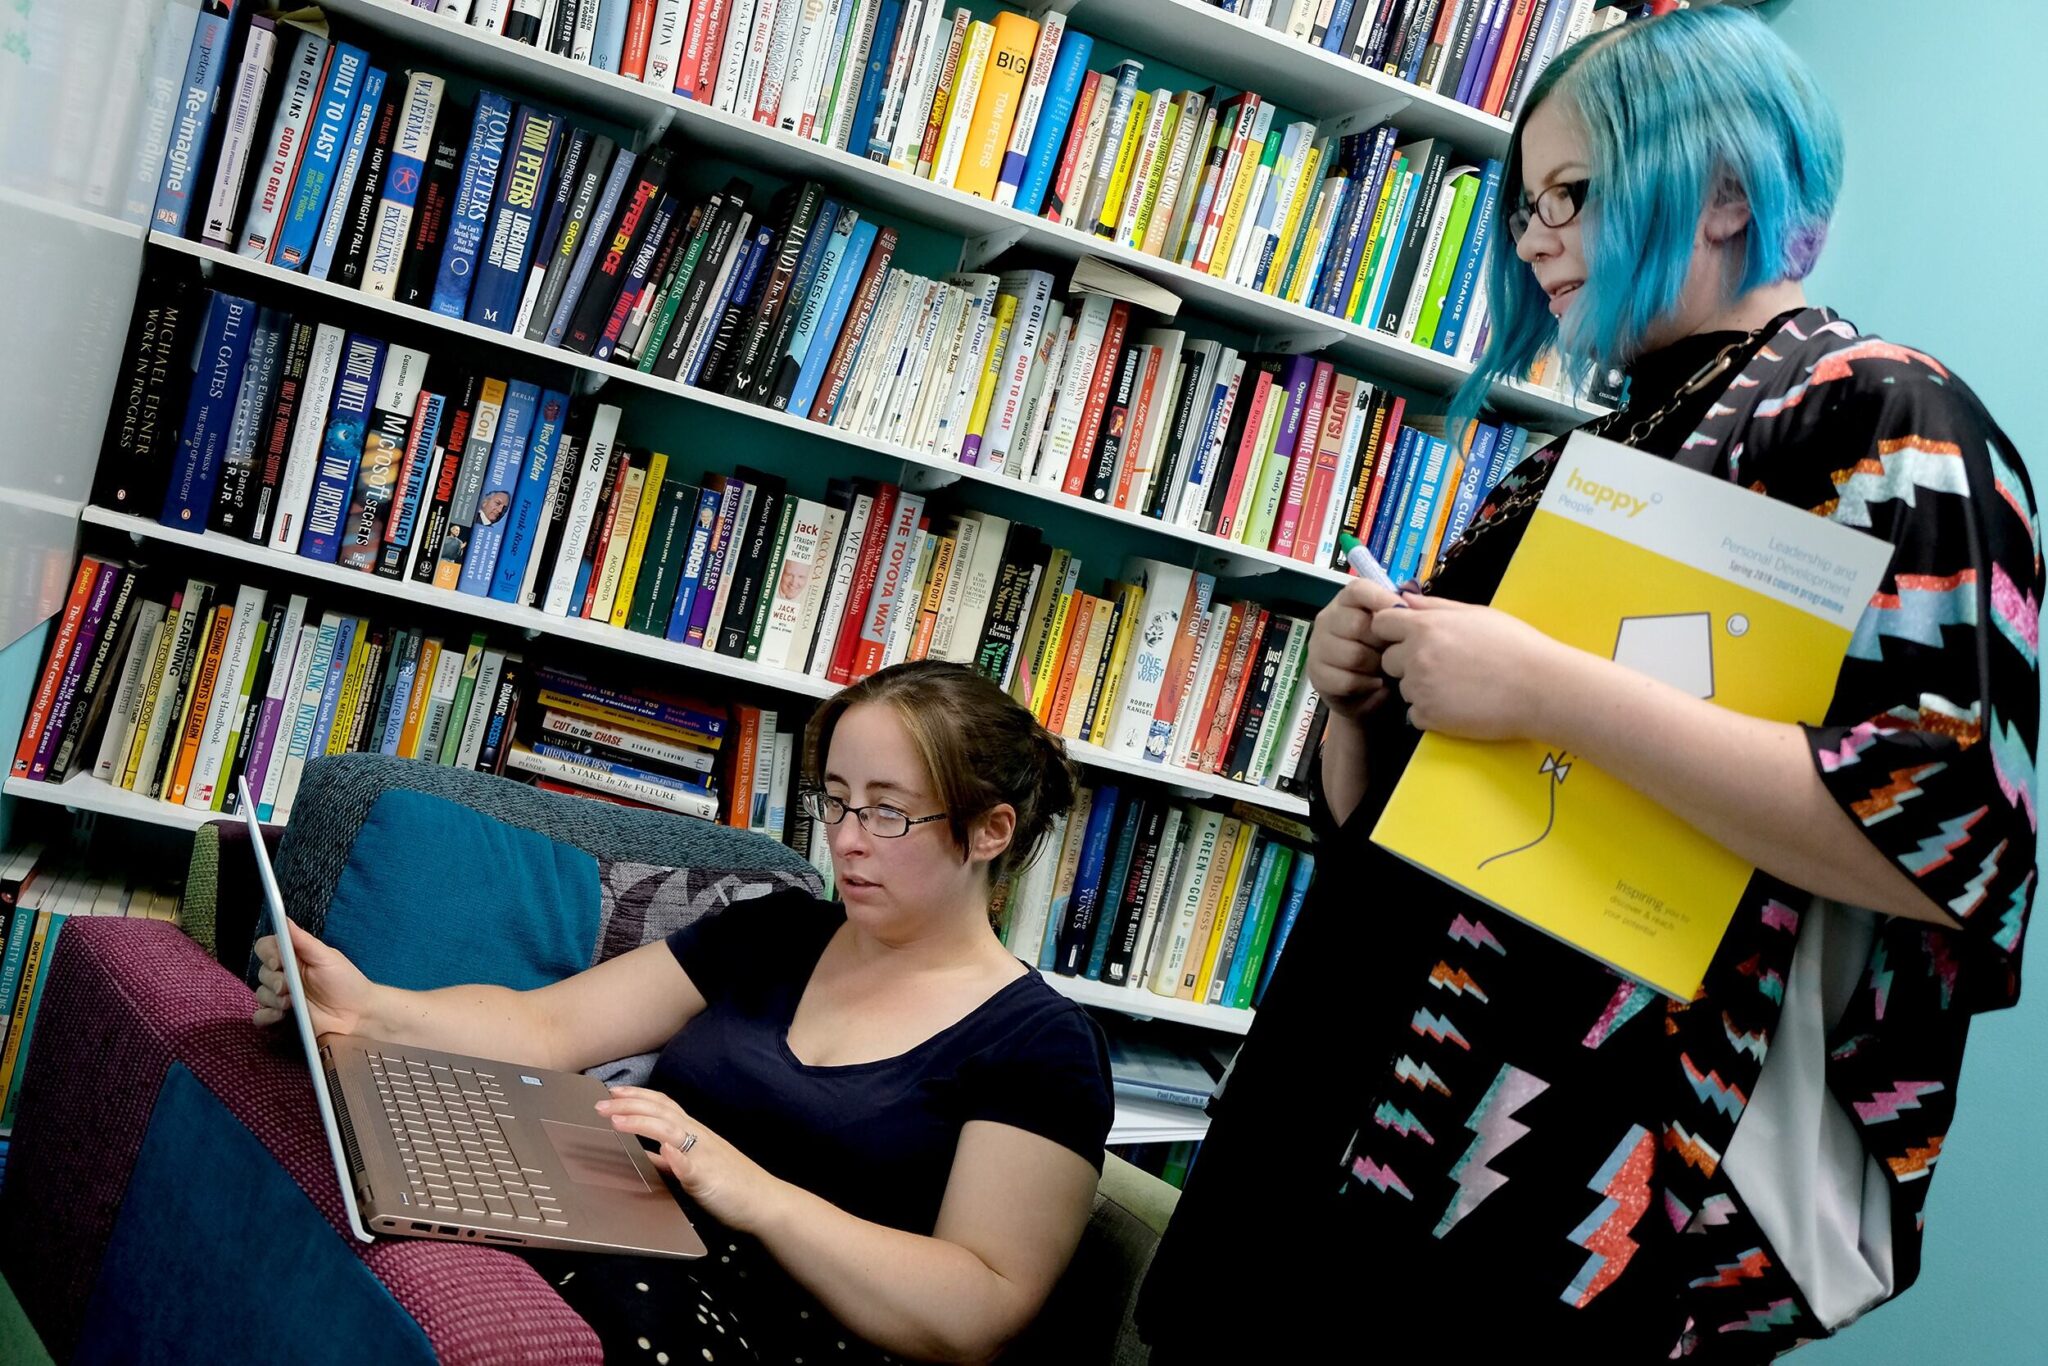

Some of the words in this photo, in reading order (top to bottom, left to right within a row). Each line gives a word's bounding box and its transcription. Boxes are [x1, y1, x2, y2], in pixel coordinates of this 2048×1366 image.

[302, 41, 318, 66] JIM
[996, 50, 1026, 74] BIG
[332, 53, 359, 98] BUILT
[287, 69, 311, 119] COLLINS
[325, 100, 346, 121] TO
[1155, 99, 1168, 117] 1001
[353, 102, 372, 145] BEYOND
[400, 79, 433, 153] WATERMAN
[1149, 118, 1162, 139] WAYS
[1235, 104, 1256, 140] Savvy
[162, 85, 208, 199] Re-imagine!
[276, 126, 295, 158] GOOD
[313, 122, 338, 162] LAST
[521, 115, 552, 152] TOM
[1146, 138, 1156, 149] TO
[1167, 116, 1195, 177] HAPPINESS
[271, 159, 286, 175] TO
[370, 147, 384, 172] HOW
[1137, 148, 1154, 180] ENERGIZE
[261, 176, 280, 213] GREAT
[322, 146, 359, 247] ENTREPRENEURSHIP
[364, 173, 378, 193] THE
[507, 150, 543, 209] PETERS
[579, 172, 597, 203] BUILT
[1158, 175, 1178, 209] NOW!
[355, 193, 373, 232] MIGHTY
[572, 203, 586, 220] TO
[797, 190, 815, 225] CHARLES
[1127, 179, 1145, 218] EMPLOYEES
[371, 205, 401, 275] EXCELLENCE
[487, 207, 514, 267] MANAGEMENT
[560, 220, 579, 256] GROW
[600, 179, 653, 275] DIFFERENCE
[1471, 194, 1494, 255] IMMUNITY
[348, 232, 363, 255] FALL
[501, 211, 532, 273] LIBERATION
[776, 223, 807, 272] HANDY
[769, 278, 786, 298] The
[866, 252, 891, 301] CAPITALISM
[1035, 280, 1047, 301] JIM
[762, 297, 778, 316] New
[860, 299, 874, 312] IS
[1451, 271, 1472, 320] CHANGE
[139, 308, 160, 352] WORK
[222, 302, 243, 341] BILL
[852, 310, 869, 338] DEAD:
[1022, 304, 1042, 347] COLLINS
[149, 306, 179, 385] MICHAEL
[743, 318, 770, 366] Alchemists
[135, 357, 149, 374] IN
[208, 344, 232, 398] GATES
[344, 340, 377, 382] INSIDE
[1013, 354, 1028, 382] GOOD
[1116, 349, 1138, 404] MAVERICK!
[336, 378, 369, 413] INTEL
[826, 378, 843, 405] RULES
[1009, 384, 1020, 397] TO
[1293, 380, 1307, 405] Open
[119, 377, 145, 448] PROGRESS
[134, 393, 160, 454] EISNER
[475, 404, 497, 438] iCon
[1000, 398, 1016, 430] GREAT
[1286, 406, 1300, 434] Minds
[1325, 389, 1350, 440] NUTS!
[413, 397, 441, 464] REVOLUTION
[1298, 407, 1322, 455] ULTIMATE
[1497, 426, 1514, 452] SID'S
[321, 455, 351, 481] TIM
[365, 413, 407, 500] Microsoft
[409, 464, 424, 478] IN
[589, 441, 607, 472] iWoz
[1422, 441, 1447, 484] THRIVING
[1484, 450, 1506, 490] HEROES
[404, 479, 421, 500] THE
[578, 478, 597, 512] Steve
[1286, 454, 1311, 506] QUESTION
[1418, 482, 1435, 499] ON
[1566, 467, 1648, 518] happy
[308, 480, 344, 536] JACKSON
[394, 501, 415, 541] VALLEY
[720, 485, 741, 538] BUSINESS
[1409, 497, 1431, 530] CHAOS
[1557, 493, 1596, 515] People
[355, 498, 378, 546] SECRETS
[563, 514, 588, 563] Wozniak
[794, 519, 819, 536] jack
[896, 506, 916, 537] THE
[683, 530, 709, 578] IACOCCA
[706, 540, 726, 591] PIONEERS
[837, 530, 862, 585] WELCH
[880, 541, 907, 598] TOYOTA
[937, 541, 952, 571] ANYONE
[1720, 535, 1773, 566] Personal
[1773, 555, 1851, 598] Development
[1767, 535, 1832, 572] Leadership
[1832, 564, 1858, 581] and
[111, 572, 136, 620] LECTURING
[928, 589, 939, 603] DO
[932, 571, 944, 589] CAN
[1728, 559, 1753, 578] Spring
[1771, 576, 1800, 595] course
[1797, 587, 1844, 614] programme
[66, 604, 81, 622] The
[242, 600, 256, 618] The
[772, 609, 797, 623] WELCH
[777, 603, 795, 614] JACK
[871, 602, 890, 637] WAY
[60, 621, 75, 637] big
[103, 619, 118, 641] AND
[166, 609, 198, 679] LEARNING
[208, 613, 228, 655] TEACHING
[231, 617, 250, 663] Accelerated
[50, 659, 61, 671] of
[54, 637, 69, 659] book
[303, 622, 339, 695] INFLUENCING
[1137, 653, 1162, 669] ONE
[1263, 645, 1282, 665] just
[83, 639, 110, 694] EXPLAINING
[198, 656, 217, 699] STUDENTS
[219, 662, 239, 699] Learning
[1137, 670, 1159, 684] WAY
[1139, 662, 1165, 678] BEST
[1264, 663, 1275, 678] do
[35, 670, 56, 711] creativity
[194, 700, 207, 713] TO
[25, 710, 42, 739] games
[187, 712, 203, 739] LEARN
[210, 699, 230, 744] Handbook
[285, 700, 318, 761] INTEGRITY
[551, 719, 571, 733] CUT
[569, 725, 579, 735] to
[579, 727, 593, 739] the
[593, 730, 623, 746] CHASE
[558, 762, 567, 772] A
[569, 765, 605, 782] STAKE
[605, 774, 616, 785] In
[616, 778, 633, 790] The
[633, 783, 675, 801] FUTURE
[1145, 844, 1157, 858] THE
[1195, 831, 1215, 871] GREEN
[1214, 839, 1234, 873] Good
[1137, 859, 1153, 893] FORTUNE
[1133, 894, 1144, 905] AT
[1183, 886, 1200, 917] GOLD
[1199, 874, 1223, 930] Business
[1615, 878, 1664, 912] Inspiring
[1129, 906, 1142, 921] THE
[28, 939, 41, 963] DON'T
[1122, 922, 1137, 952] BOTTOM
[20, 982, 30, 995] ME
[23, 962, 36, 983] MAKE
[15, 995, 28, 1019] THINK!
